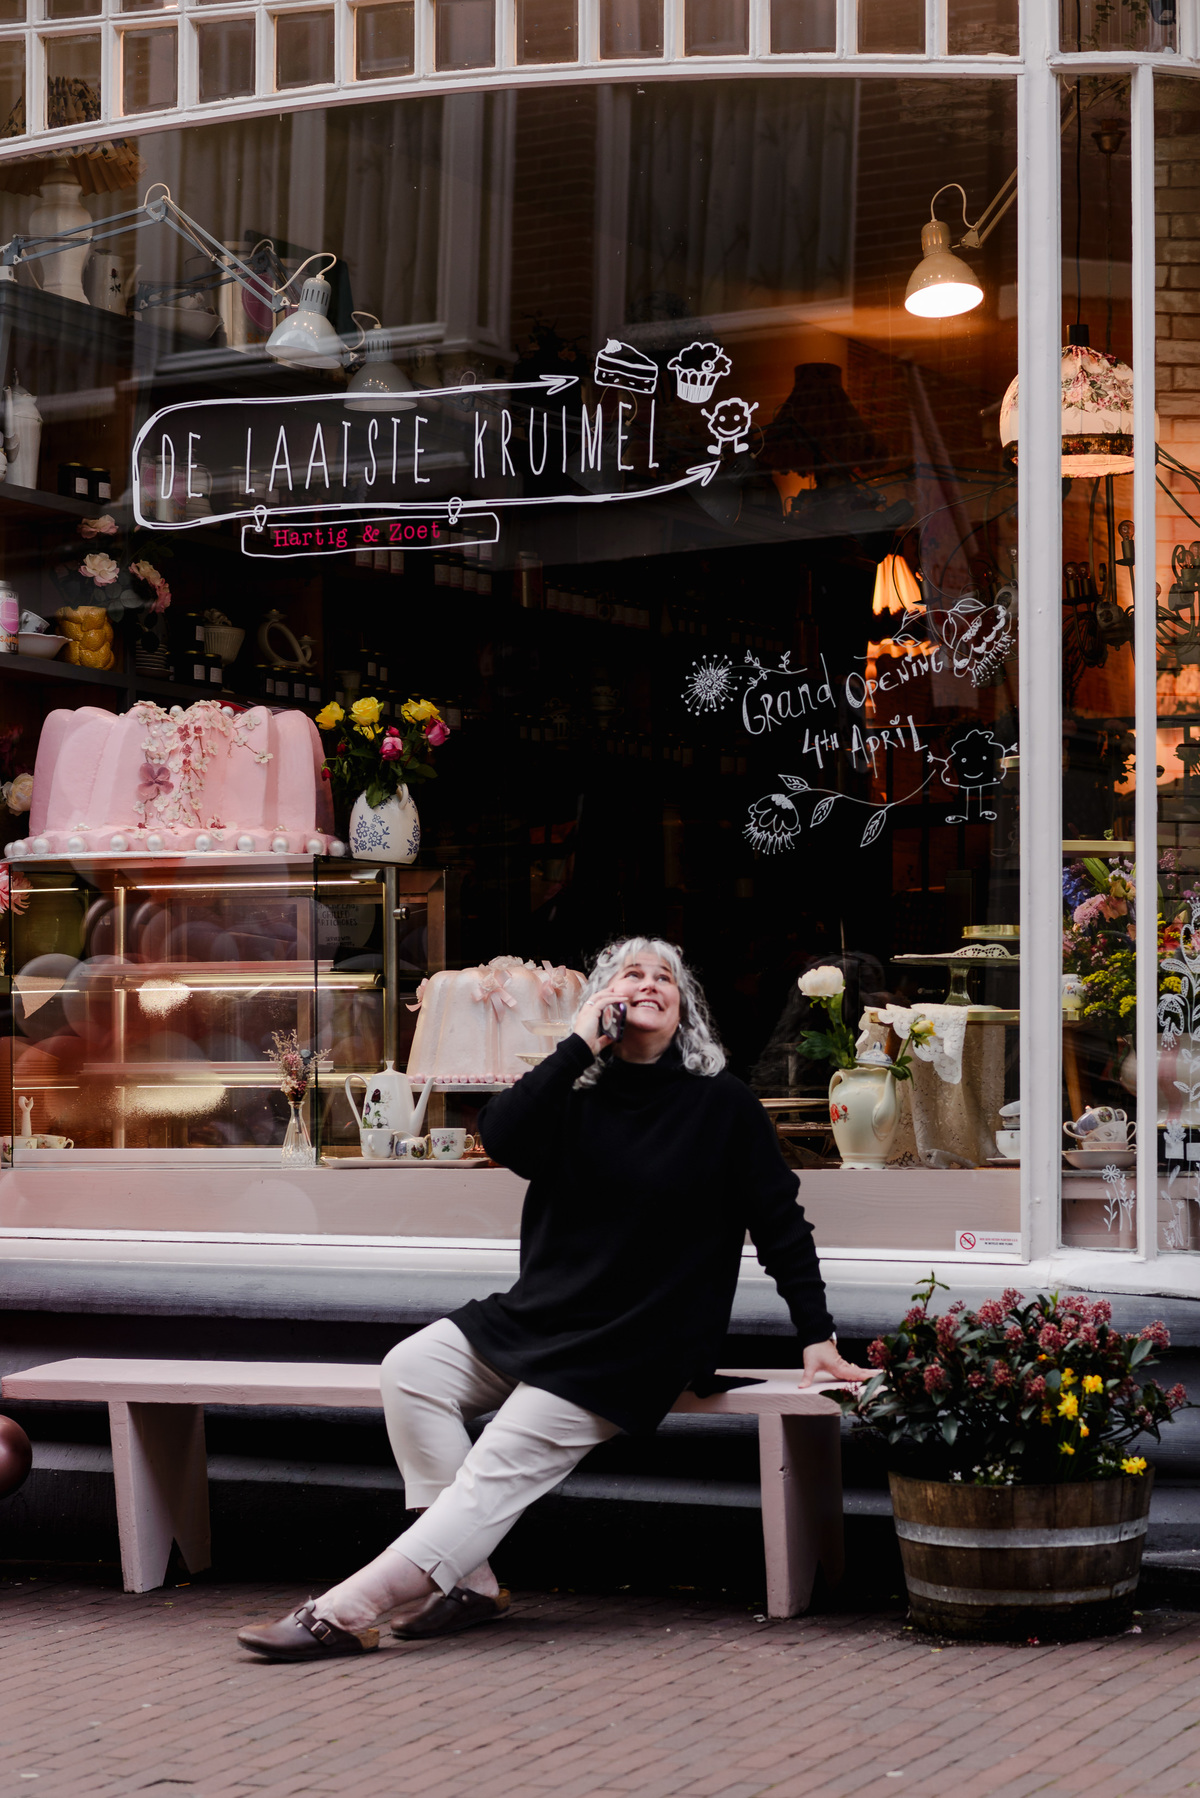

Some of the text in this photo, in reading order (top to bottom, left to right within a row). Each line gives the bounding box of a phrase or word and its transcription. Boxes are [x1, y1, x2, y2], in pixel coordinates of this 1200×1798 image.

[160, 400, 660, 499] DE LAATSTE KRUIMEL
[273, 521, 441, 549] Hartig & Zoet
